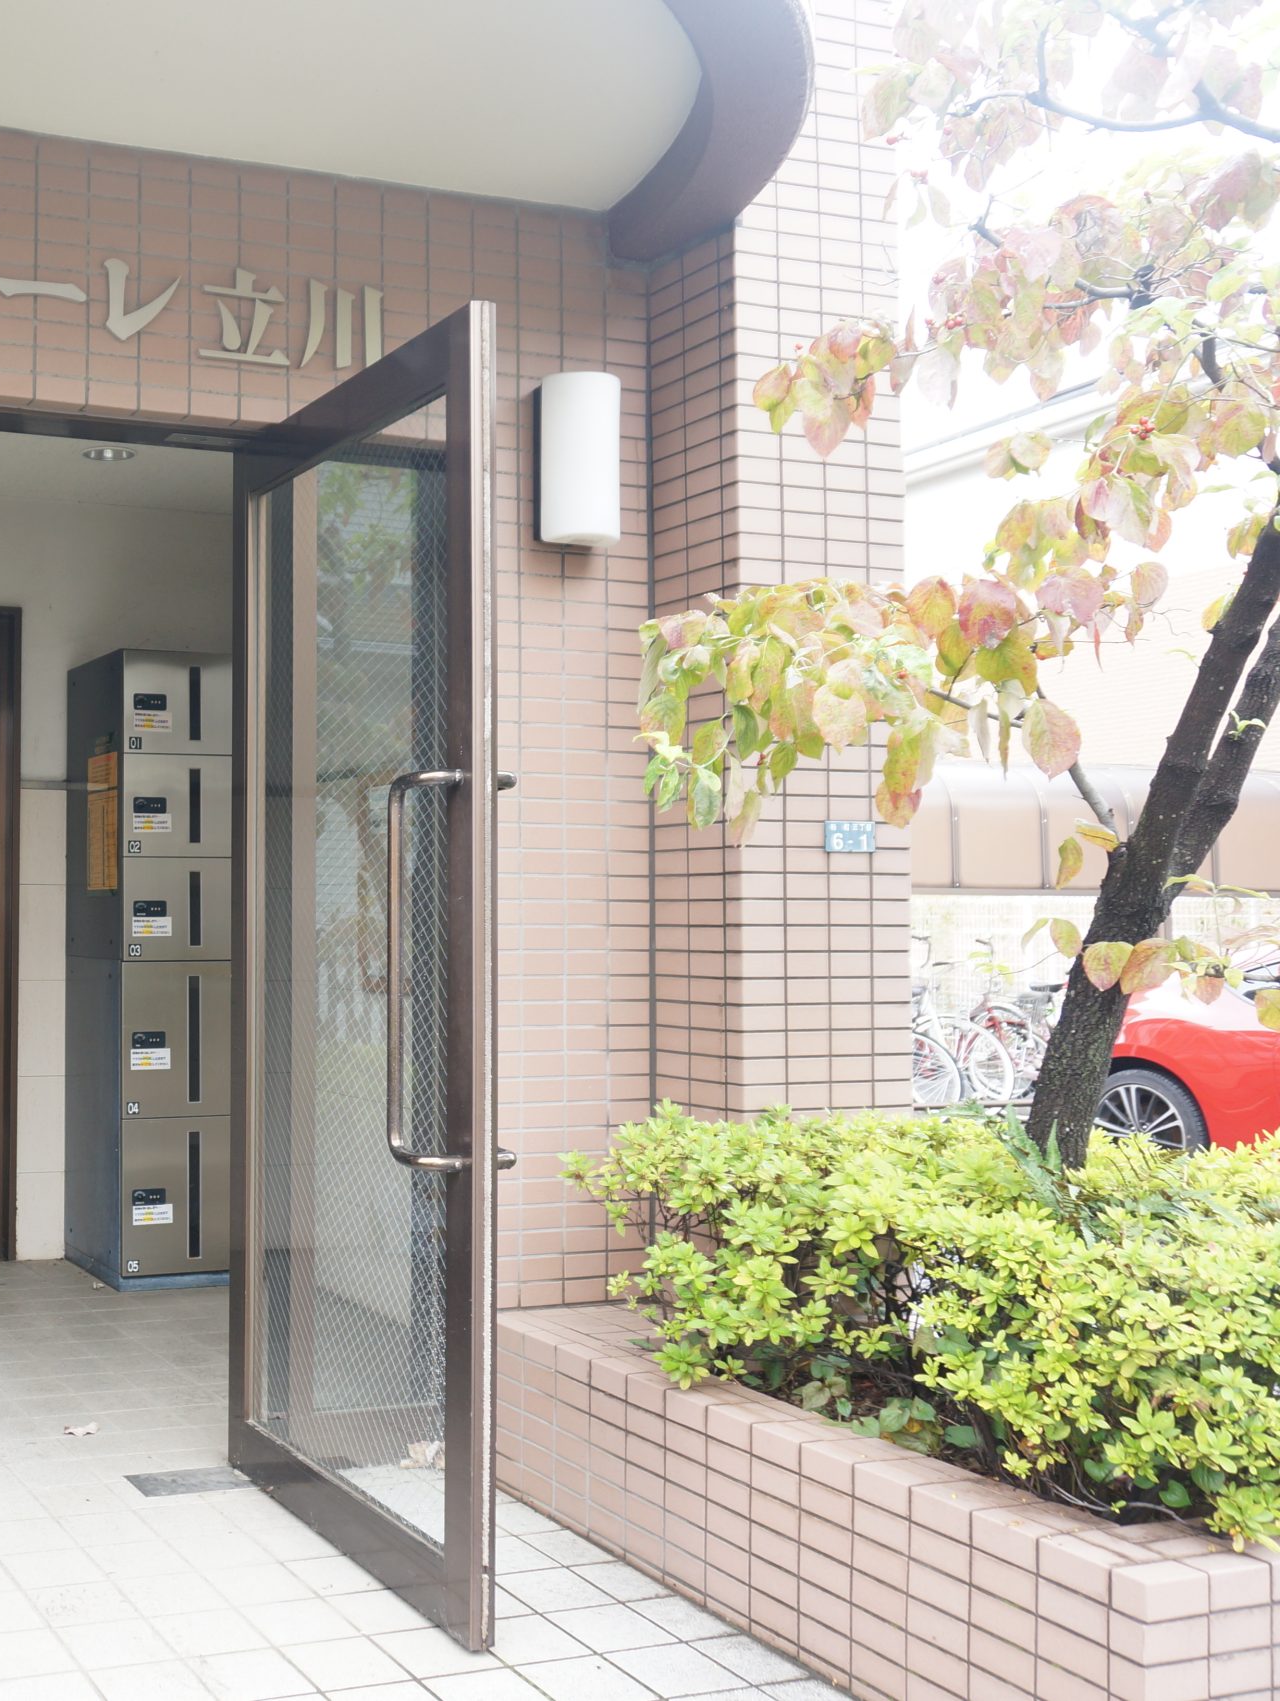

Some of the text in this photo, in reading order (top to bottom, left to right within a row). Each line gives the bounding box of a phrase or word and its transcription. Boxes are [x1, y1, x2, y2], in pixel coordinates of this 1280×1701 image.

[130, 737, 140, 749] 01
[129, 841, 141, 852] 02
[832, 832, 868, 851] 6-1
[129, 944, 141, 956] 03
[127, 1102, 139, 1114] 04
[127, 1260, 139, 1272] 05
